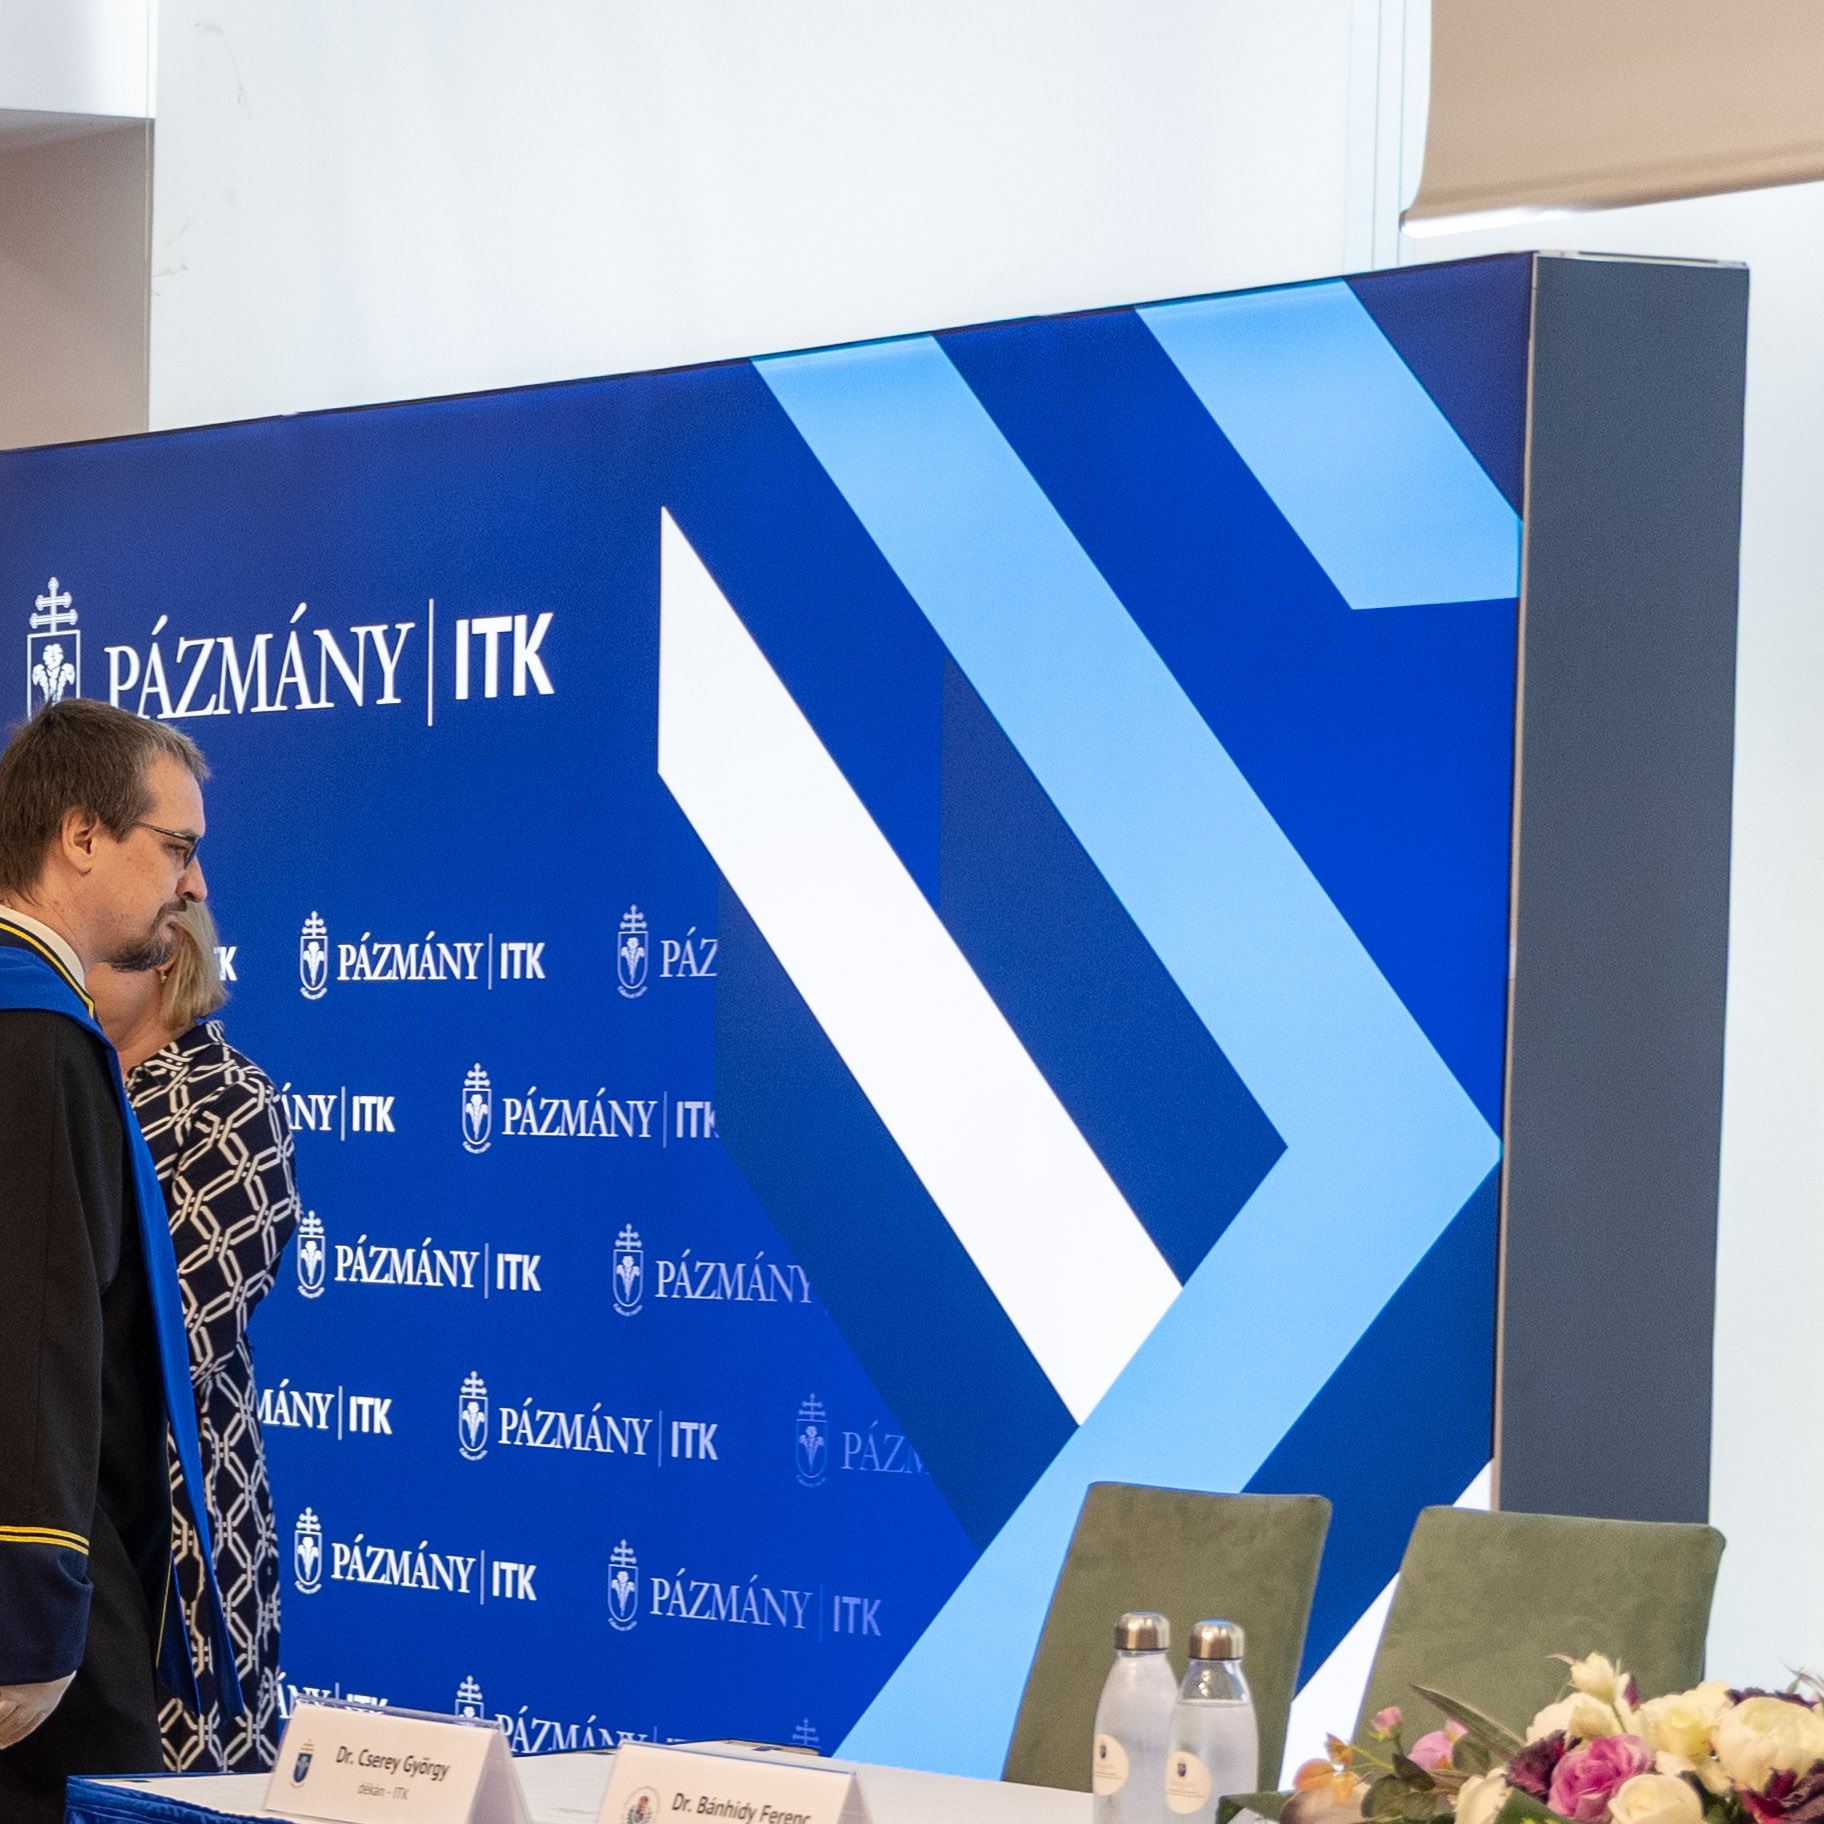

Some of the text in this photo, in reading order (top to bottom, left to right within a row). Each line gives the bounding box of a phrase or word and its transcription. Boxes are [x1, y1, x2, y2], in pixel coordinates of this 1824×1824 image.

[104, 602, 554, 720] PÁZMÁNY ITK
[337, 931, 546, 981] PÁZMÁNY ITK
[352, 1096, 396, 1133] ITK
[502, 1086, 658, 1138] PÁZMÁNY
[334, 1234, 542, 1292] PÁZMÁNY ITK
[655, 1249, 812, 1303] PÁZMÁNY
[349, 1396, 393, 1435] ITK
[498, 1397, 718, 1461] PÁZMÁNY ITK
[331, 1534, 537, 1601] PÁZMÁNY ITK
[650, 1568, 882, 1637] PÁZMÁNY ITK
[336, 1745, 450, 1782] Dr. Cserey György
[393, 1786, 410, 1800] ITK
[672, 1792, 692, 1813] Dr.
